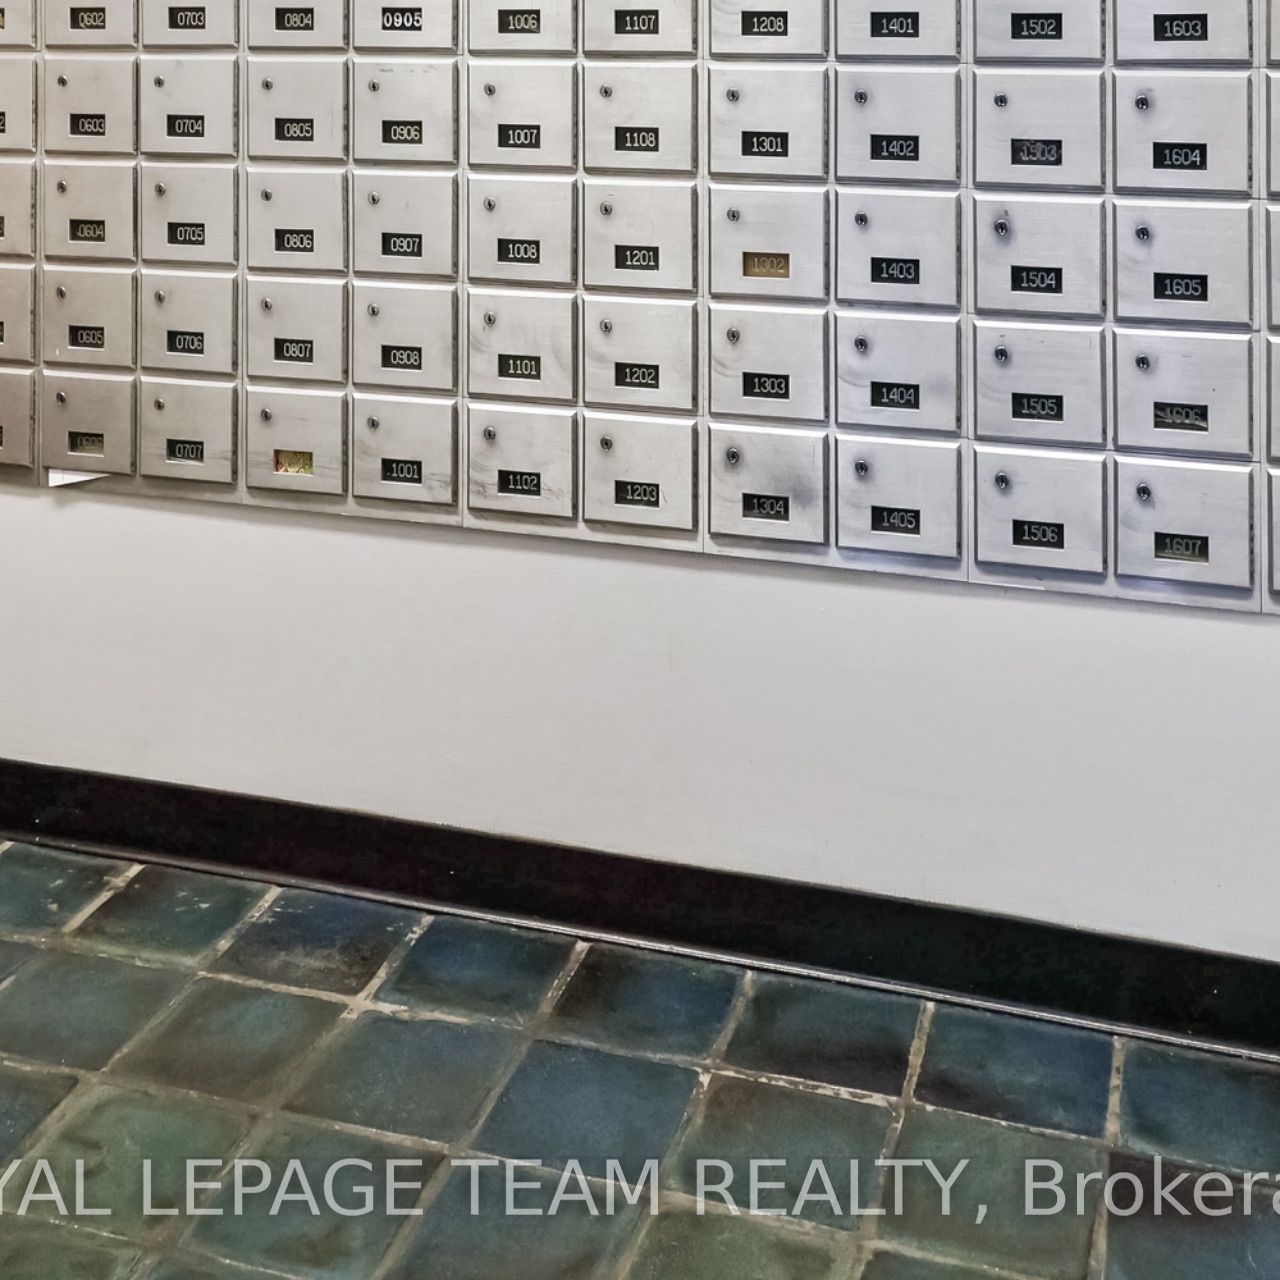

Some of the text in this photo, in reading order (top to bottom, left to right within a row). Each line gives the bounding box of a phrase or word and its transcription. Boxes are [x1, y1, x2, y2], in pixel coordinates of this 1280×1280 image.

[79, 12, 104, 26] 0602
[178, 12, 204, 26] 0703
[285, 13, 311, 28] 0804
[385, 13, 421, 28] 0905
[509, 14, 537, 30] 1006
[626, 15, 655, 31] 1107
[753, 17, 784, 33] 1208
[882, 18, 914, 34] 1401
[1022, 19, 1056, 36] 1502
[1165, 20, 1201, 37] 1603
[79, 119, 104, 132] 0603
[176, 119, 202, 134] 0704
[284, 123, 311, 138] 0805
[391, 126, 419, 141] 0906
[509, 129, 537, 145] 1007
[626, 132, 655, 148] 1108
[752, 137, 782, 152] 1301
[882, 141, 914, 157] 1402
[1164, 149, 1200, 166] 1604
[79, 224, 105, 239] 0604
[178, 227, 203, 241] 0705
[284, 234, 311, 249] 0806
[391, 238, 419, 253] 0907
[509, 244, 537, 259] 1008
[626, 251, 655, 266] 1201
[881, 262, 914, 279] 1403
[1021, 272, 1056, 289] 1504
[1165, 279, 1201, 296] 1605
[78, 330, 103, 344] 0605
[176, 335, 202, 350] 0706
[284, 343, 311, 358] 0807
[391, 350, 419, 366] 0908
[509, 360, 536, 375] 1101
[626, 368, 655, 384] 1202
[754, 378, 785, 394] 1303
[882, 388, 914, 404] 1404
[1022, 398, 1057, 415] 1505
[176, 444, 202, 456] 0707
[392, 463, 418, 479] 1001
[509, 475, 537, 491] 1102
[627, 486, 656, 502] 1203
[753, 499, 784, 515] 1304
[883, 512, 915, 529] 1405
[1023, 525, 1057, 543] 1506
